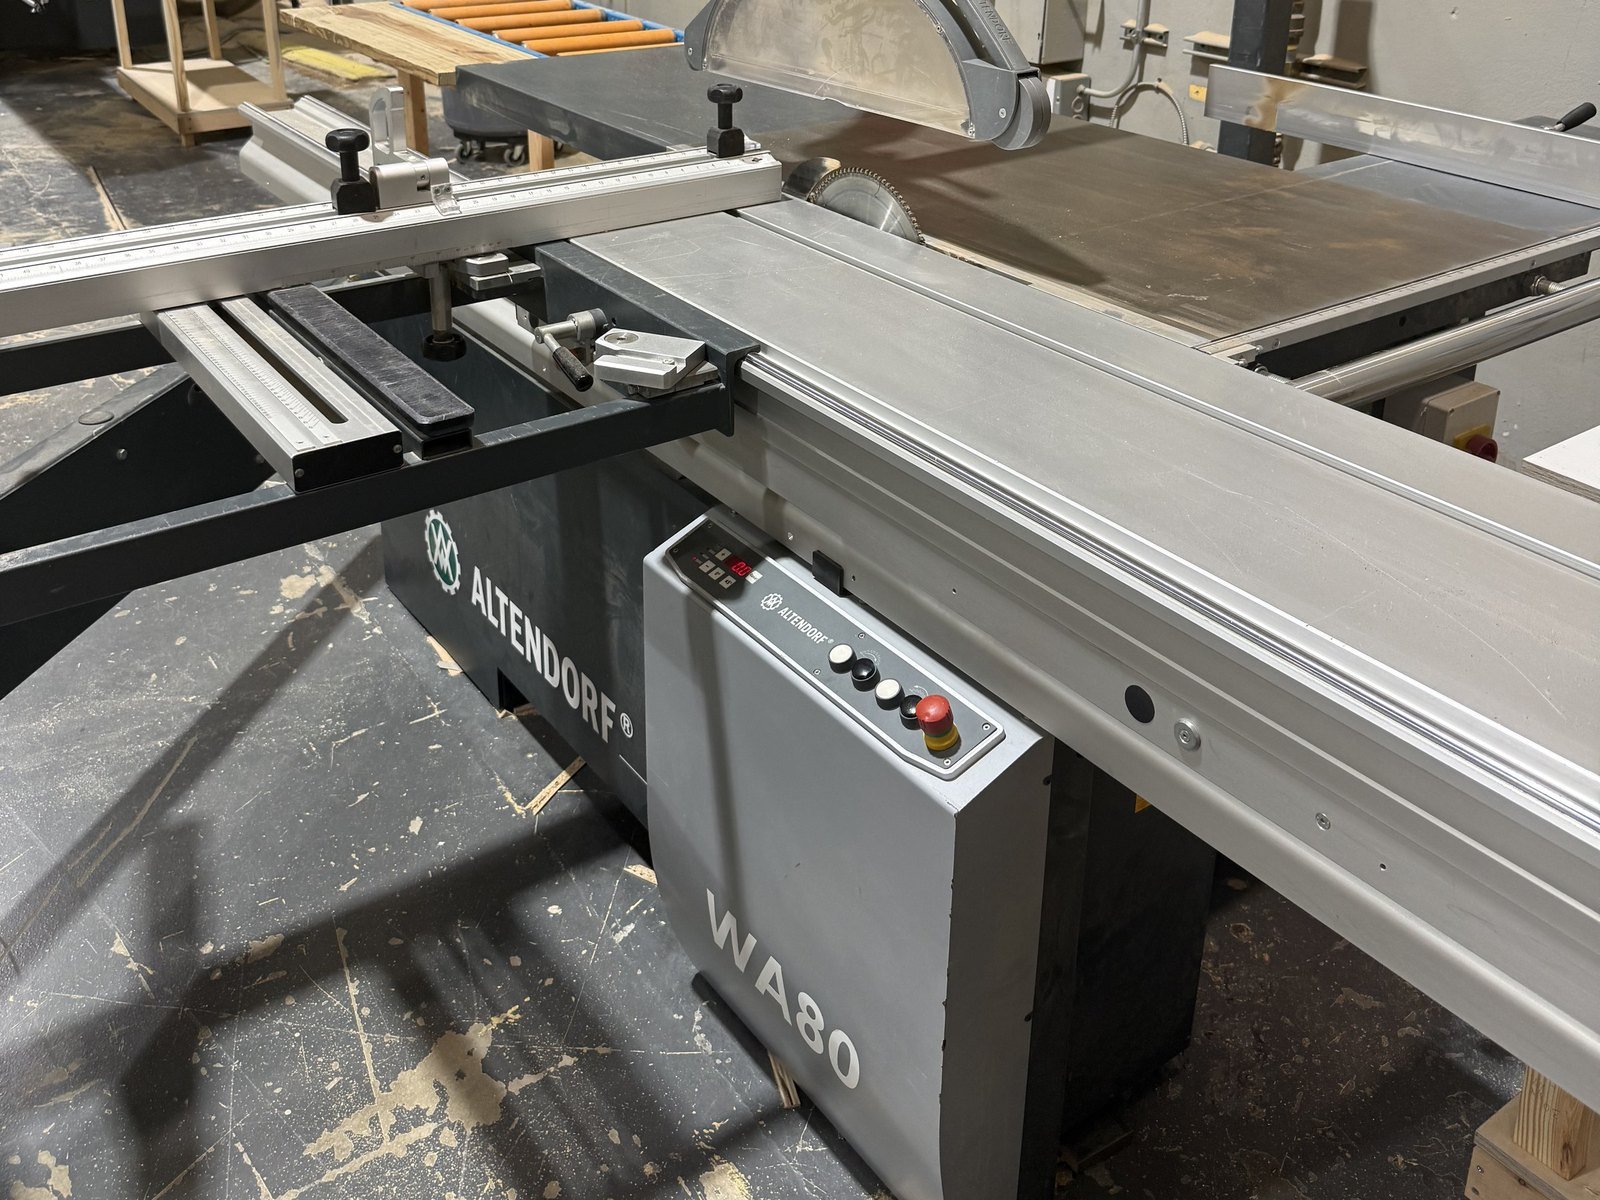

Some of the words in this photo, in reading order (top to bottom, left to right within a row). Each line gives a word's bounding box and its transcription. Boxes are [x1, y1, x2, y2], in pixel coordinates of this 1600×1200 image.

[471, 565, 617, 744] ALTENDORF
[777, 606, 829, 644] ALTENDORF
[706, 888, 860, 1090] WA80
